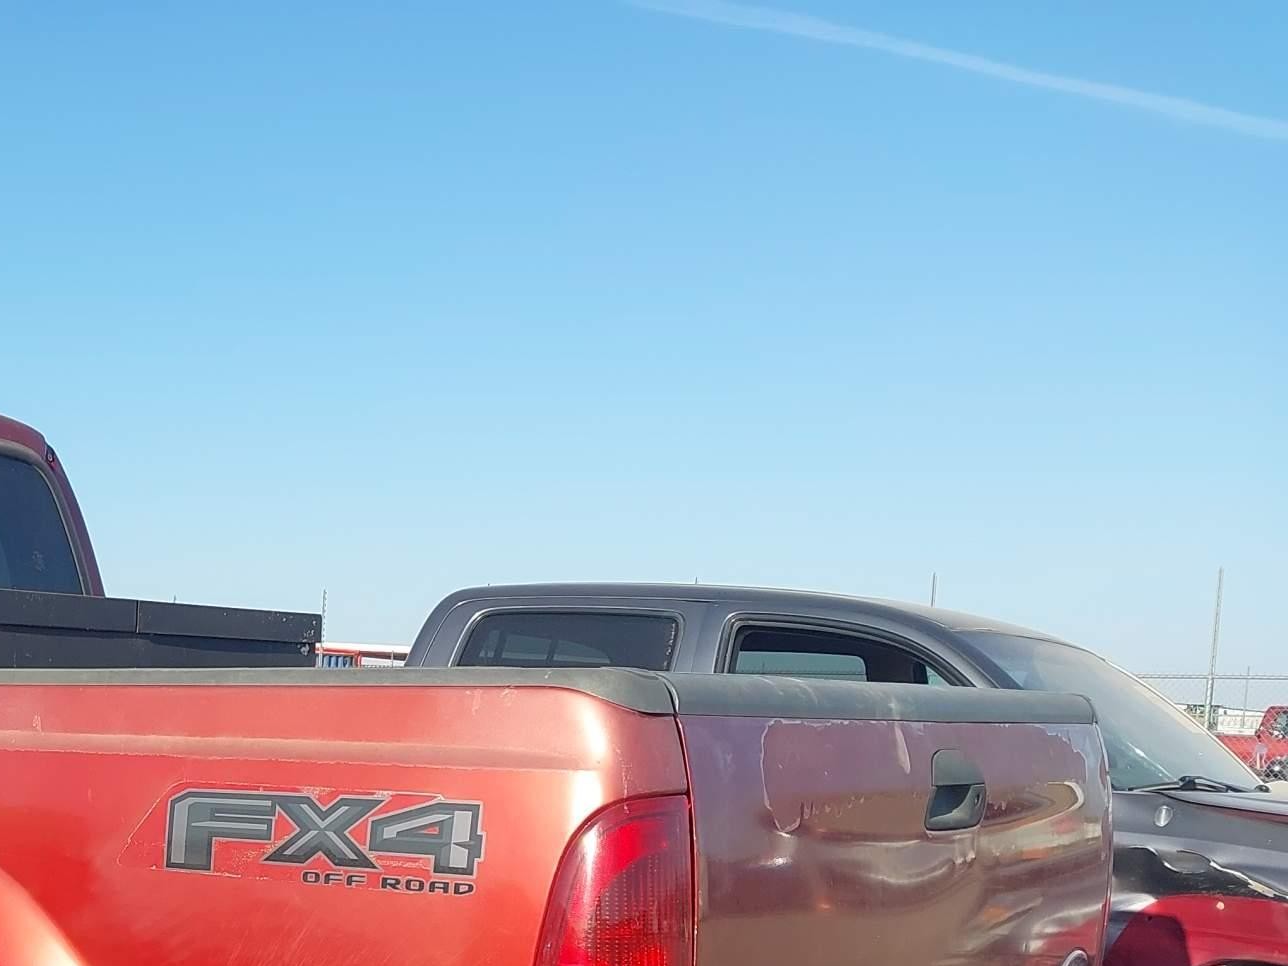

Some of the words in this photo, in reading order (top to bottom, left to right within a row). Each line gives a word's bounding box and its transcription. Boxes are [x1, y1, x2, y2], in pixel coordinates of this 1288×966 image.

[165, 788, 487, 878] FX4
[302, 870, 367, 887] OFF
[380, 876, 475, 896] ROAD
